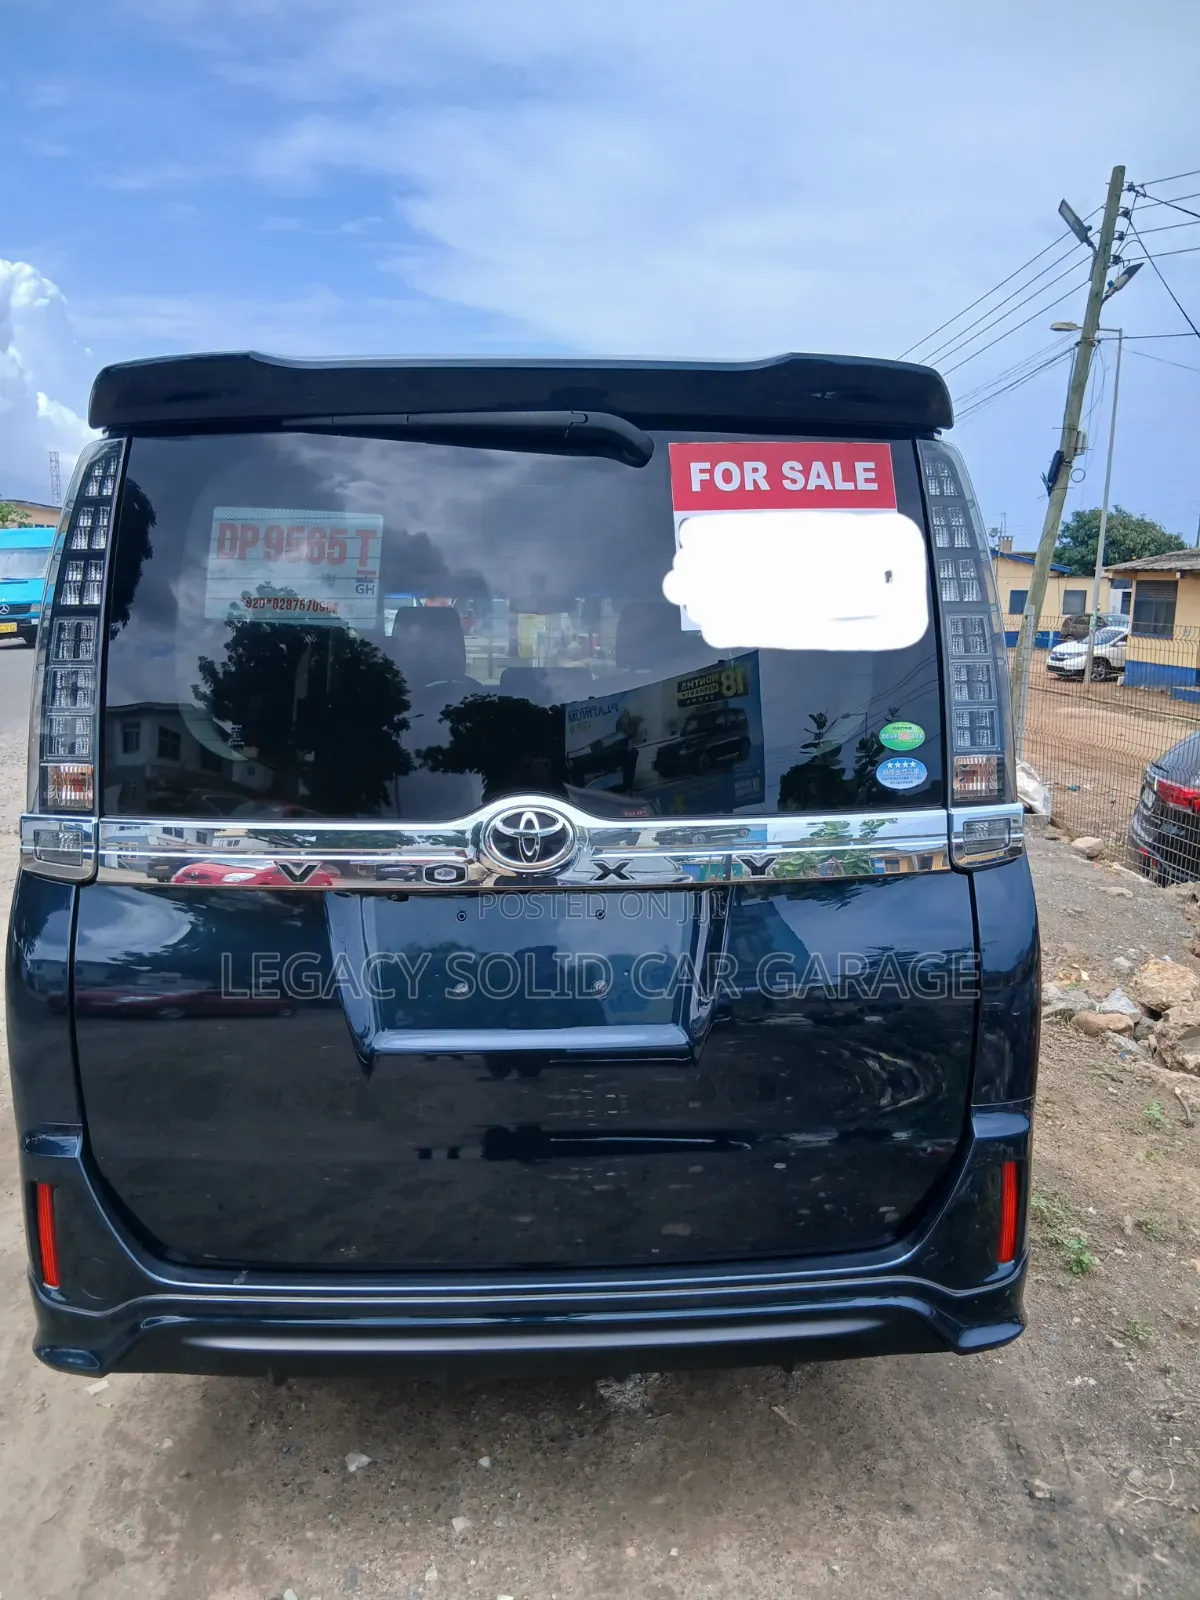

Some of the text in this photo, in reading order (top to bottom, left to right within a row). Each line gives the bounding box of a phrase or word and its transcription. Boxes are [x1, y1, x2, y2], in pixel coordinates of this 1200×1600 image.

[690, 461, 878, 491] FOR SALE
[217, 522, 260, 560] DP
[355, 529, 377, 567] T
[355, 583, 375, 595] GH
